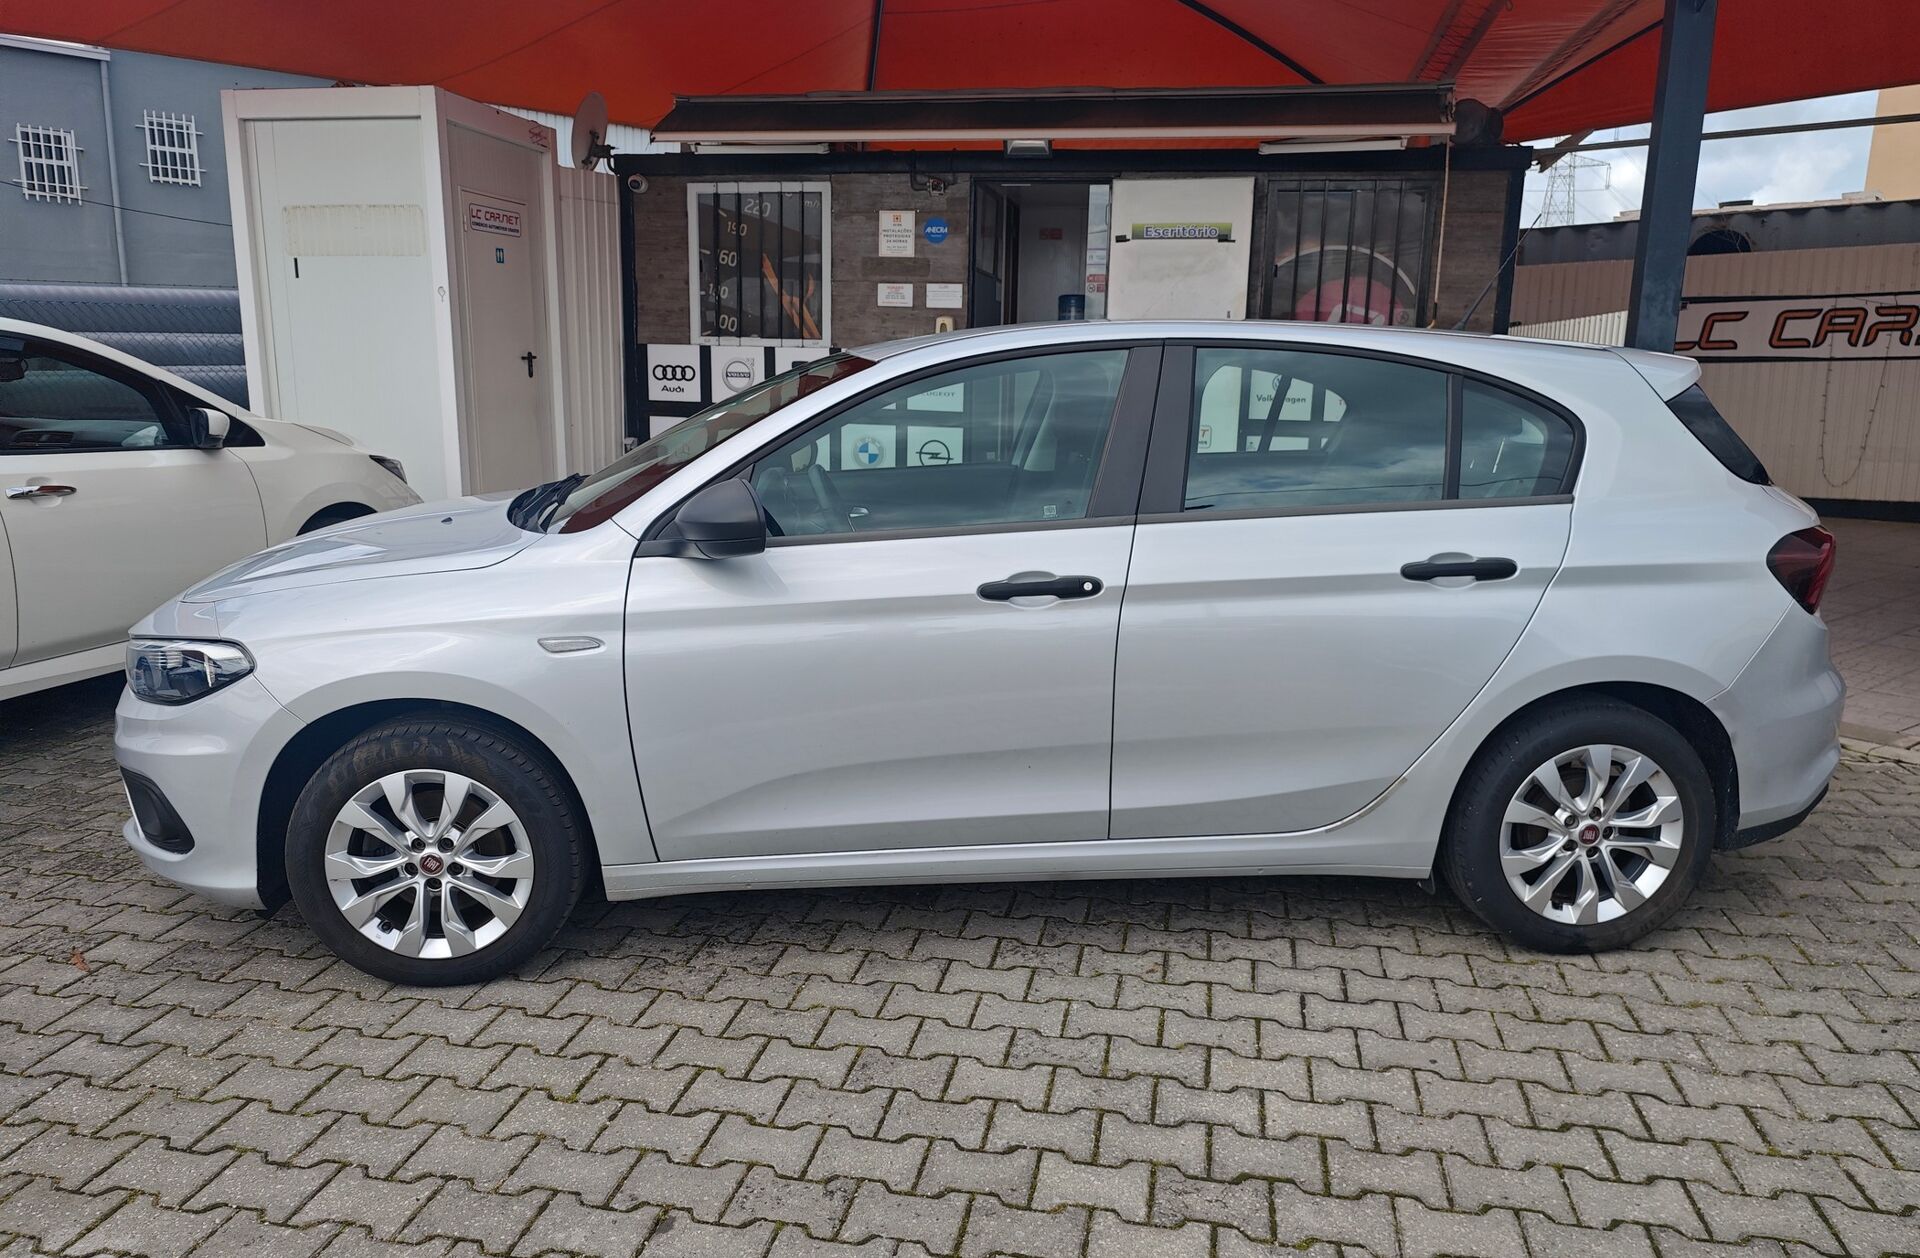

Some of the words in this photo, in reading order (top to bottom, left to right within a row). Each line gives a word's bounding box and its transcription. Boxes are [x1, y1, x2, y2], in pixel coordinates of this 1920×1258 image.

[744, 199, 771, 217] 220
[1143, 224, 1219, 238] Escritório
[718, 250, 737, 267] 60
[714, 314, 737, 332] 00
[661, 385, 685, 393] Audi
[424, 857, 440, 871] FIAT
